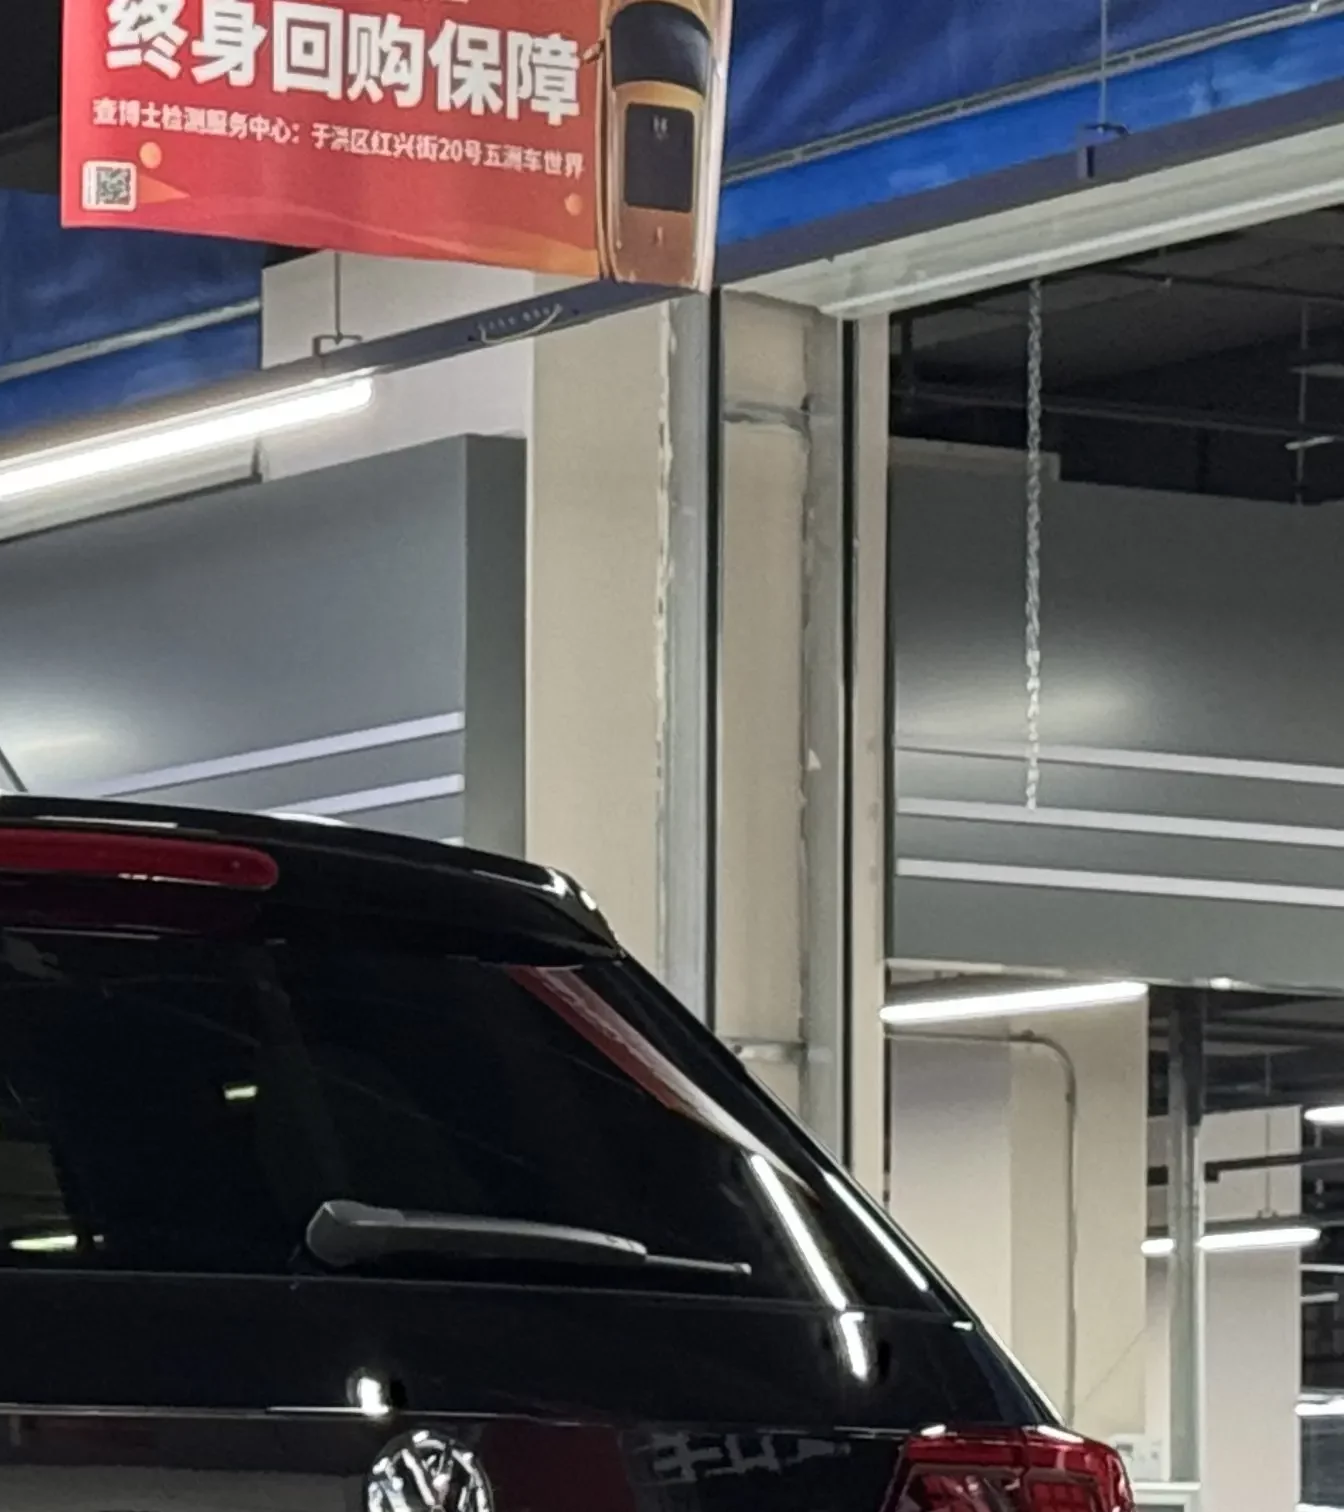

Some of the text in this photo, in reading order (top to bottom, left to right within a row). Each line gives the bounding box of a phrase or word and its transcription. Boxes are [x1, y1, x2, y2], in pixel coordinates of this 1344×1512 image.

[105, 0, 581, 125] 终身回购保障
